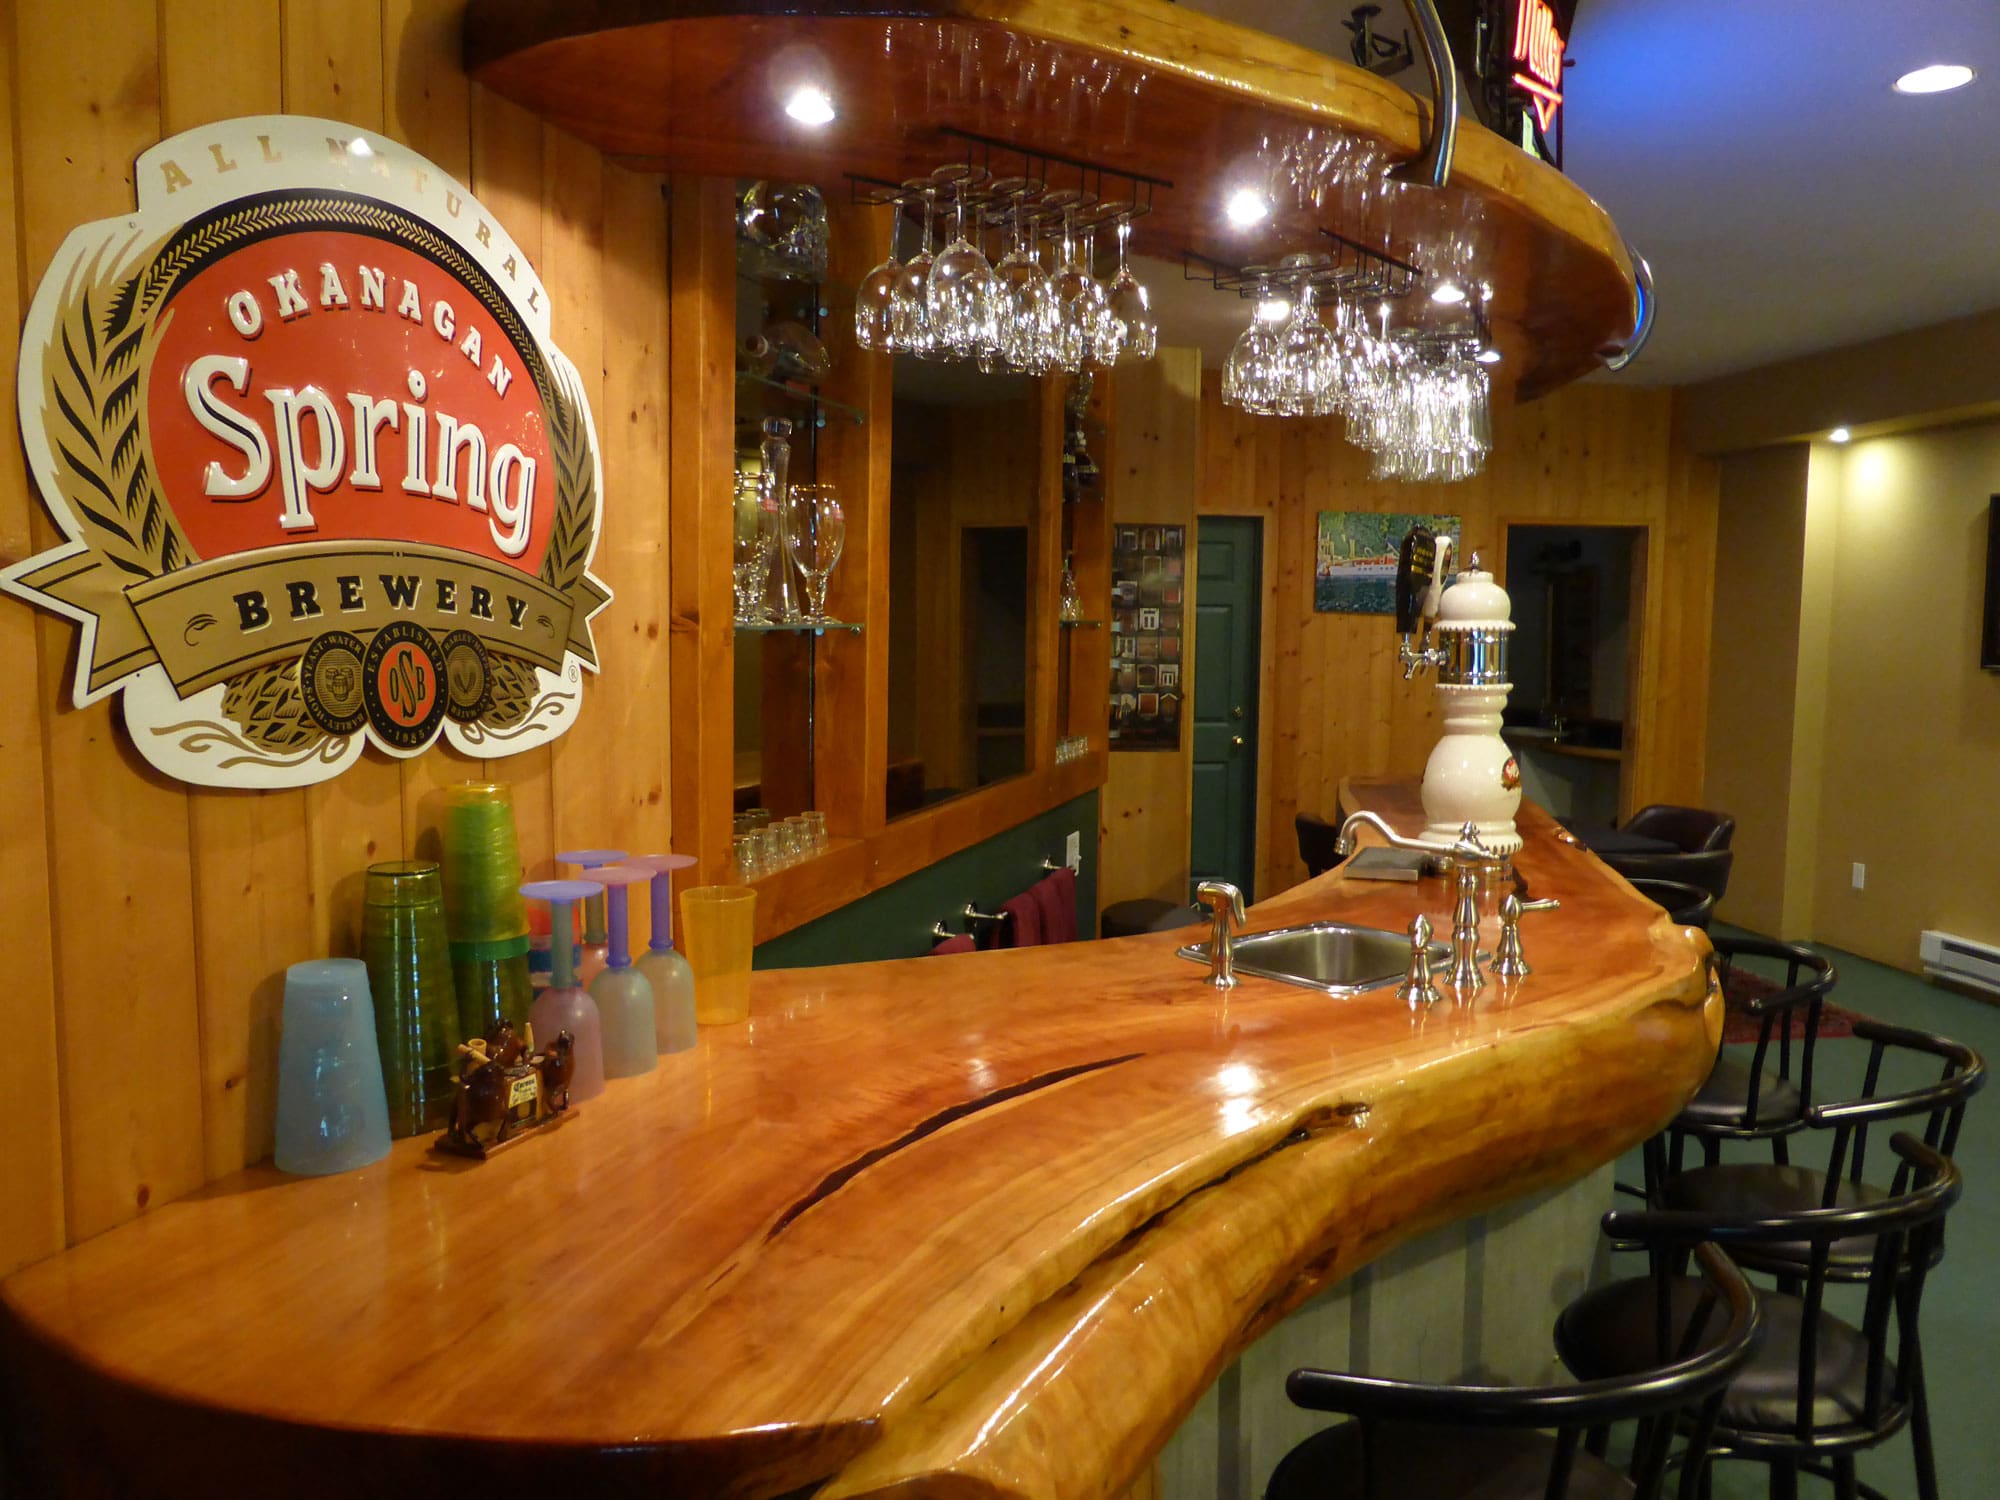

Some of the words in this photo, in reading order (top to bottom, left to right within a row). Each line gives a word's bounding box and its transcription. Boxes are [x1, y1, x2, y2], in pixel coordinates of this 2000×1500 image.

[160, 135, 282, 193] ALL
[326, 136, 542, 313] NATURAL
[228, 262, 513, 399] OKANAGAN
[184, 354, 537, 558] Spring
[233, 574, 528, 634] BREWERY
[328, 635, 362, 654] WATER
[367, 626, 443, 673] ESTABLISHED
